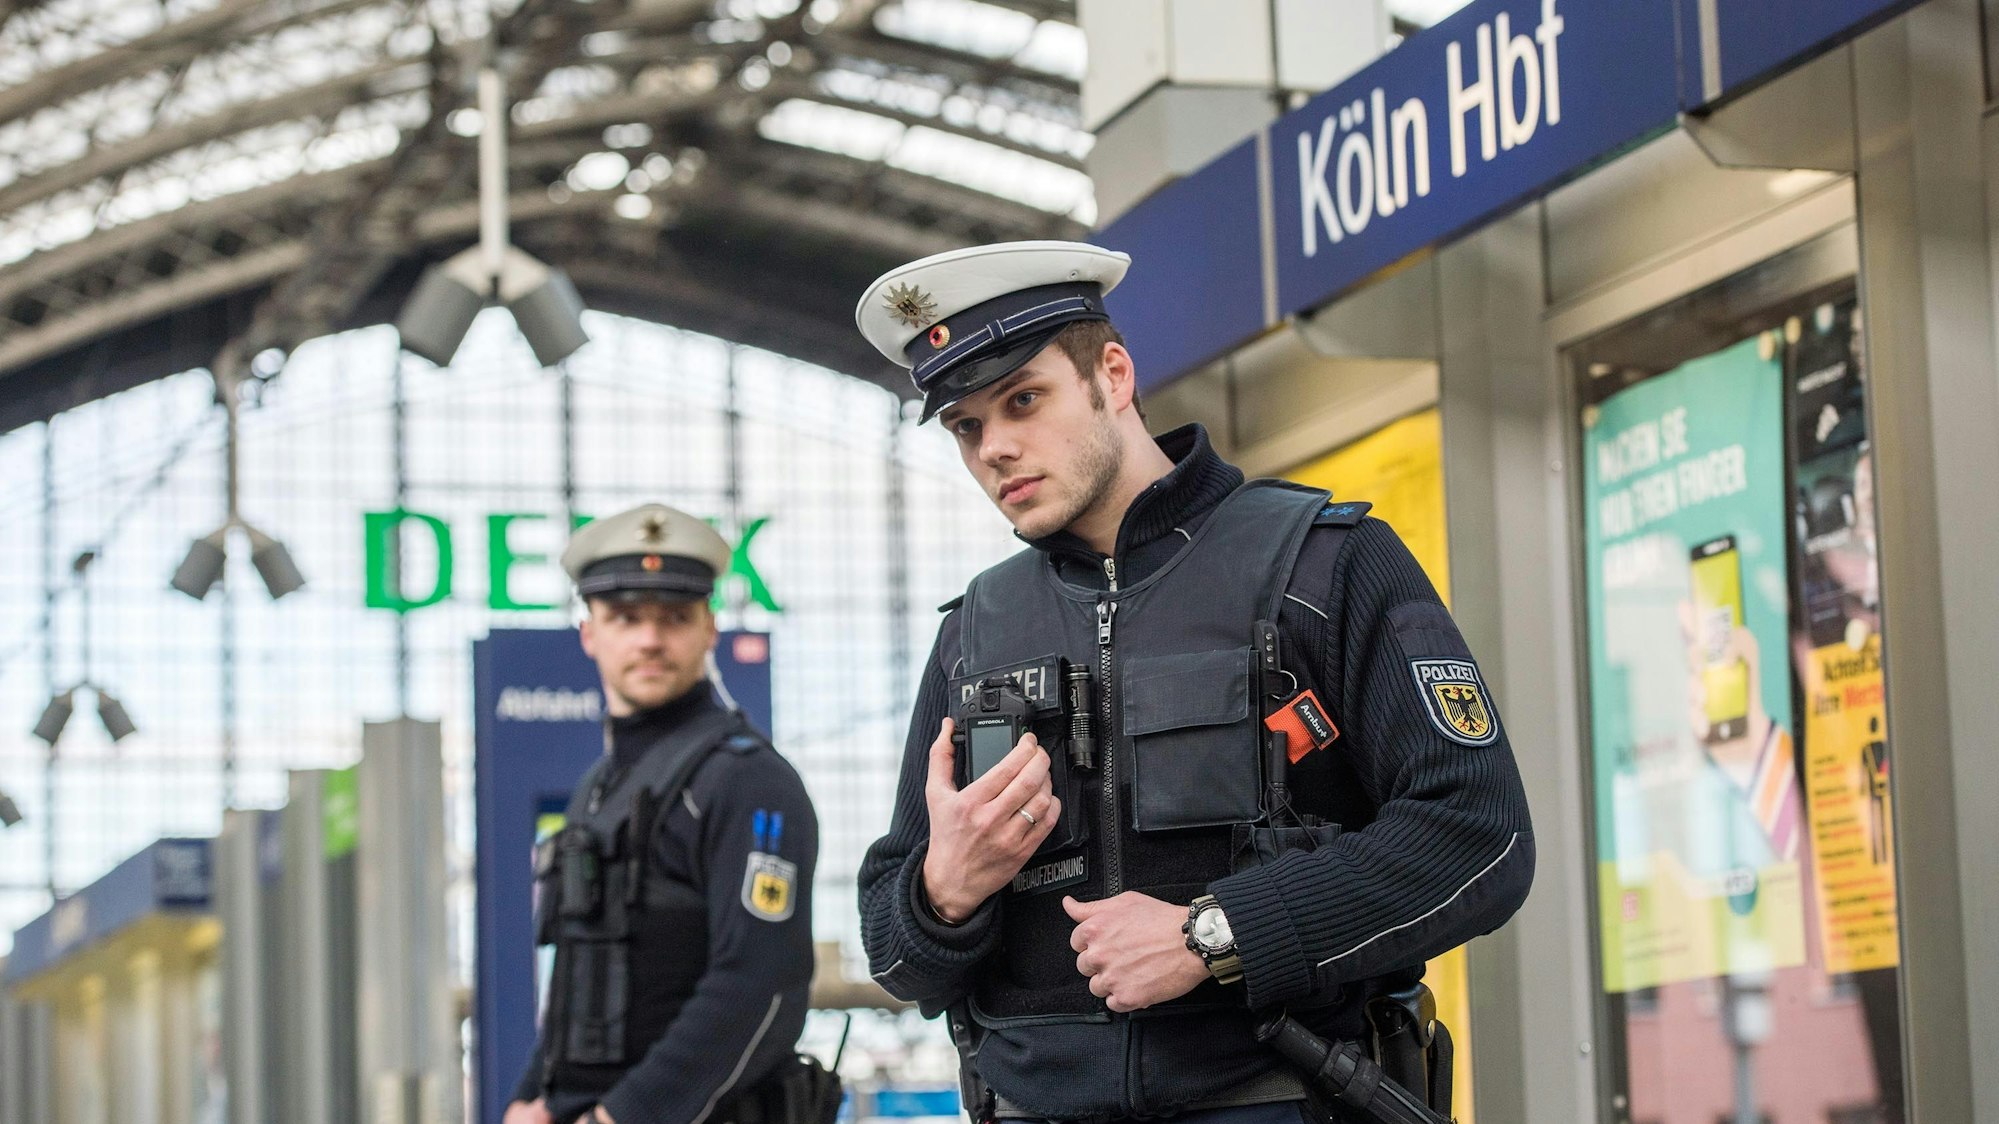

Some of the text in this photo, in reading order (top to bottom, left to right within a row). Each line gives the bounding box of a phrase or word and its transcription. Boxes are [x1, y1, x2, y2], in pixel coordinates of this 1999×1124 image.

[1297, 0, 1564, 257] Köln Hbf
[1678, 444, 1747, 507] FINGER
[364, 509, 784, 615] DEK
[496, 685, 601, 721] Abfahrt
[1420, 664, 1477, 683] POLIZEI
